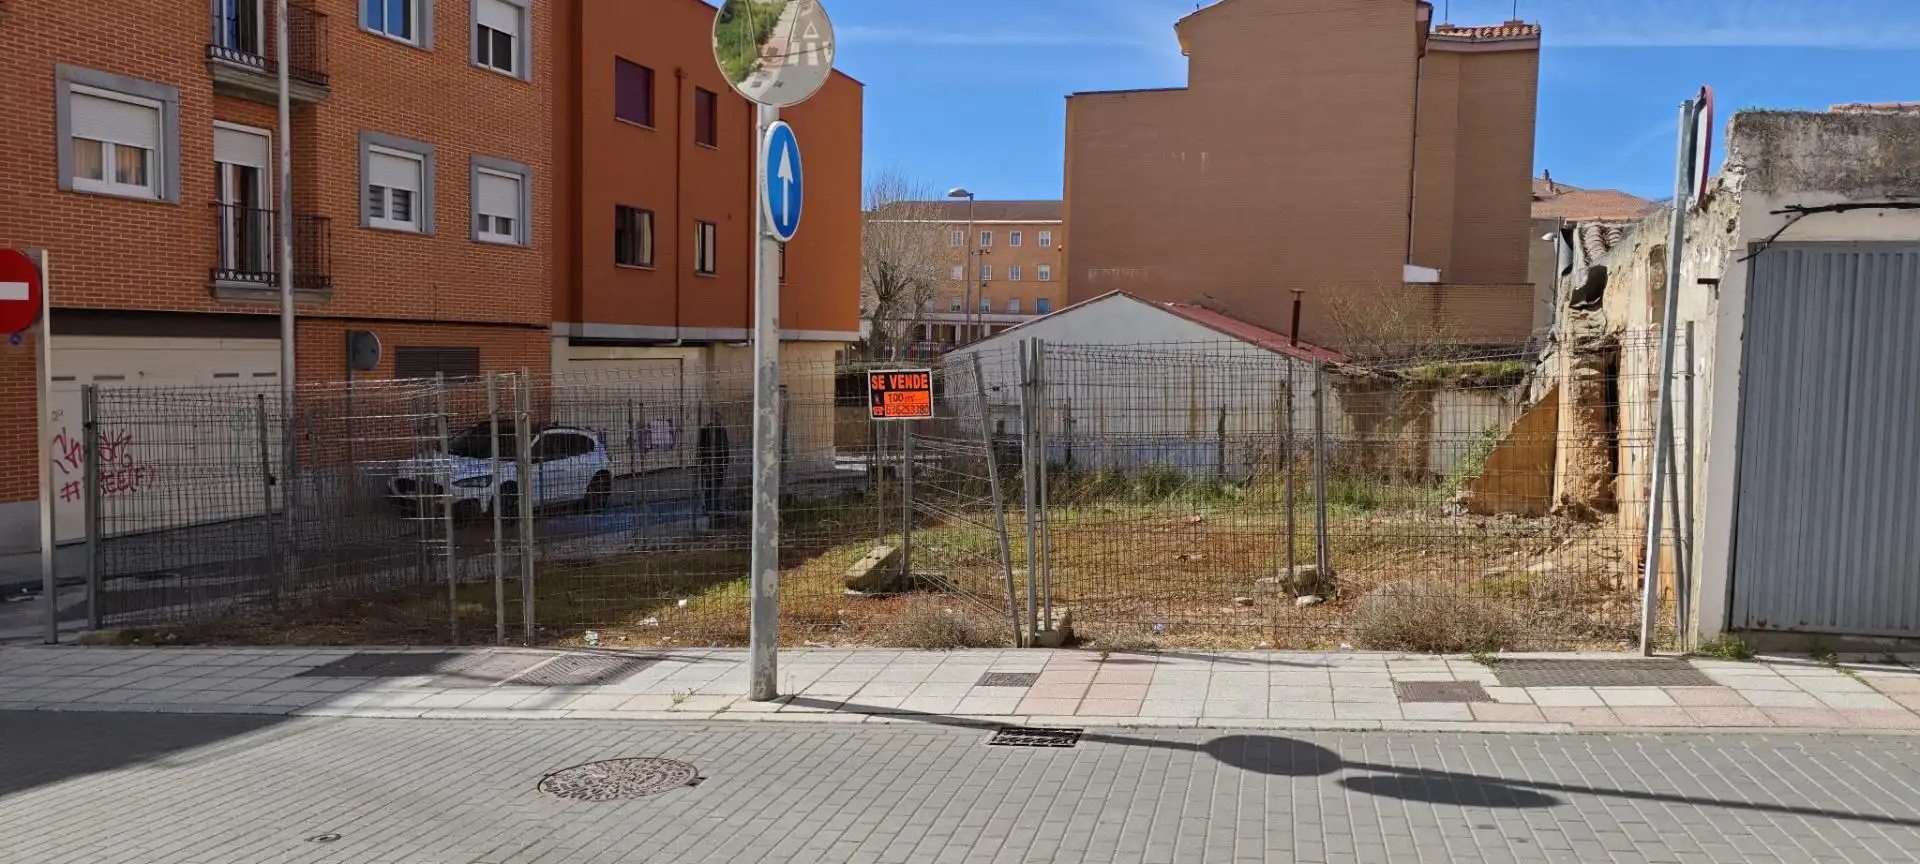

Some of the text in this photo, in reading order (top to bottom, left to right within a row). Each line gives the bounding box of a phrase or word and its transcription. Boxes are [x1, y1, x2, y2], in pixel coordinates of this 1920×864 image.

[872, 374, 928, 390] SE VENDE
[888, 393, 904, 402] 100
